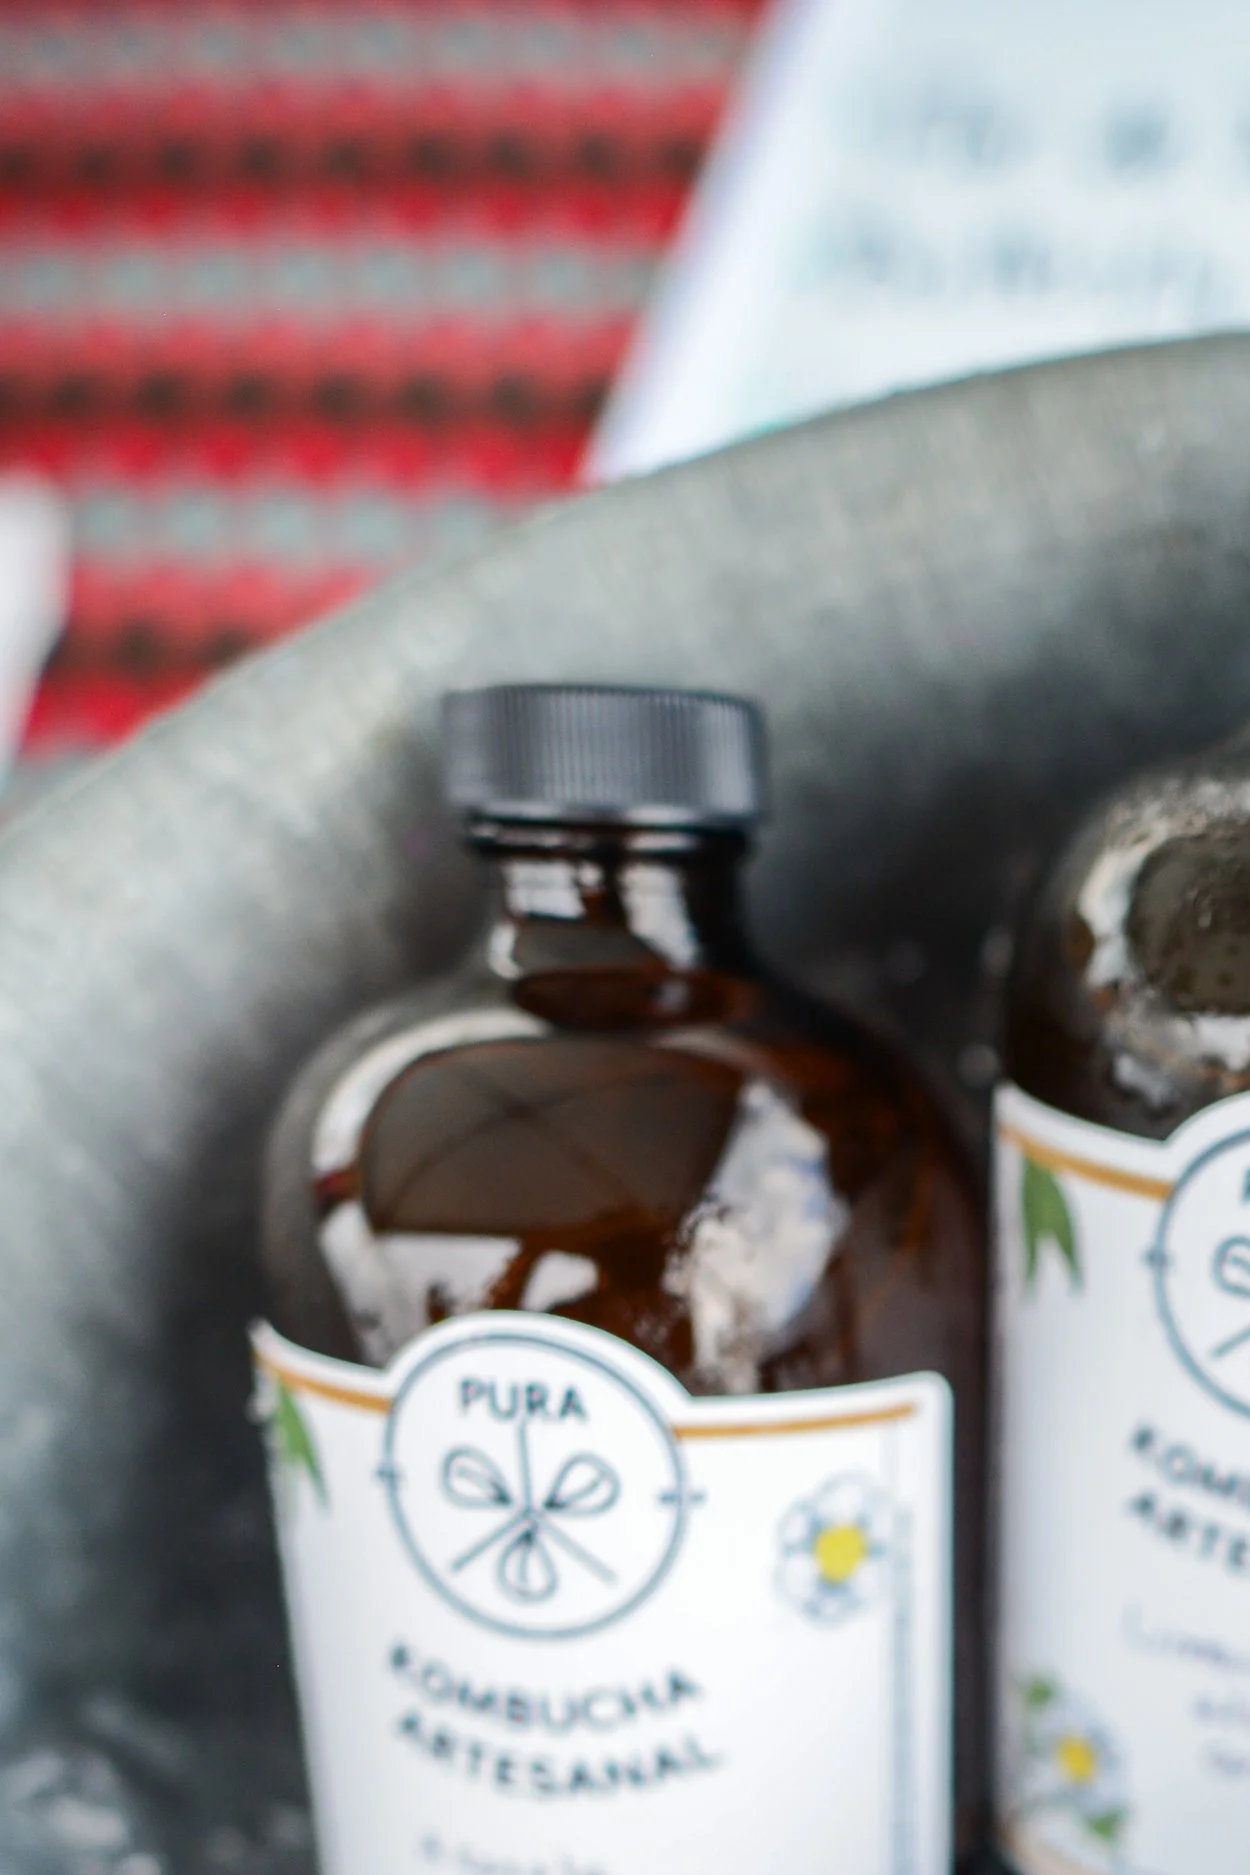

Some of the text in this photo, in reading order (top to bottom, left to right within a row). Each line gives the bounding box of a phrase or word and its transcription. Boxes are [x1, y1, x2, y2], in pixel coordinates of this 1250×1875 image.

[459, 1377, 589, 1425] PURA
[389, 1641, 700, 1734] KOMBUCHA
[397, 1709, 722, 1798] ARTESANAL
